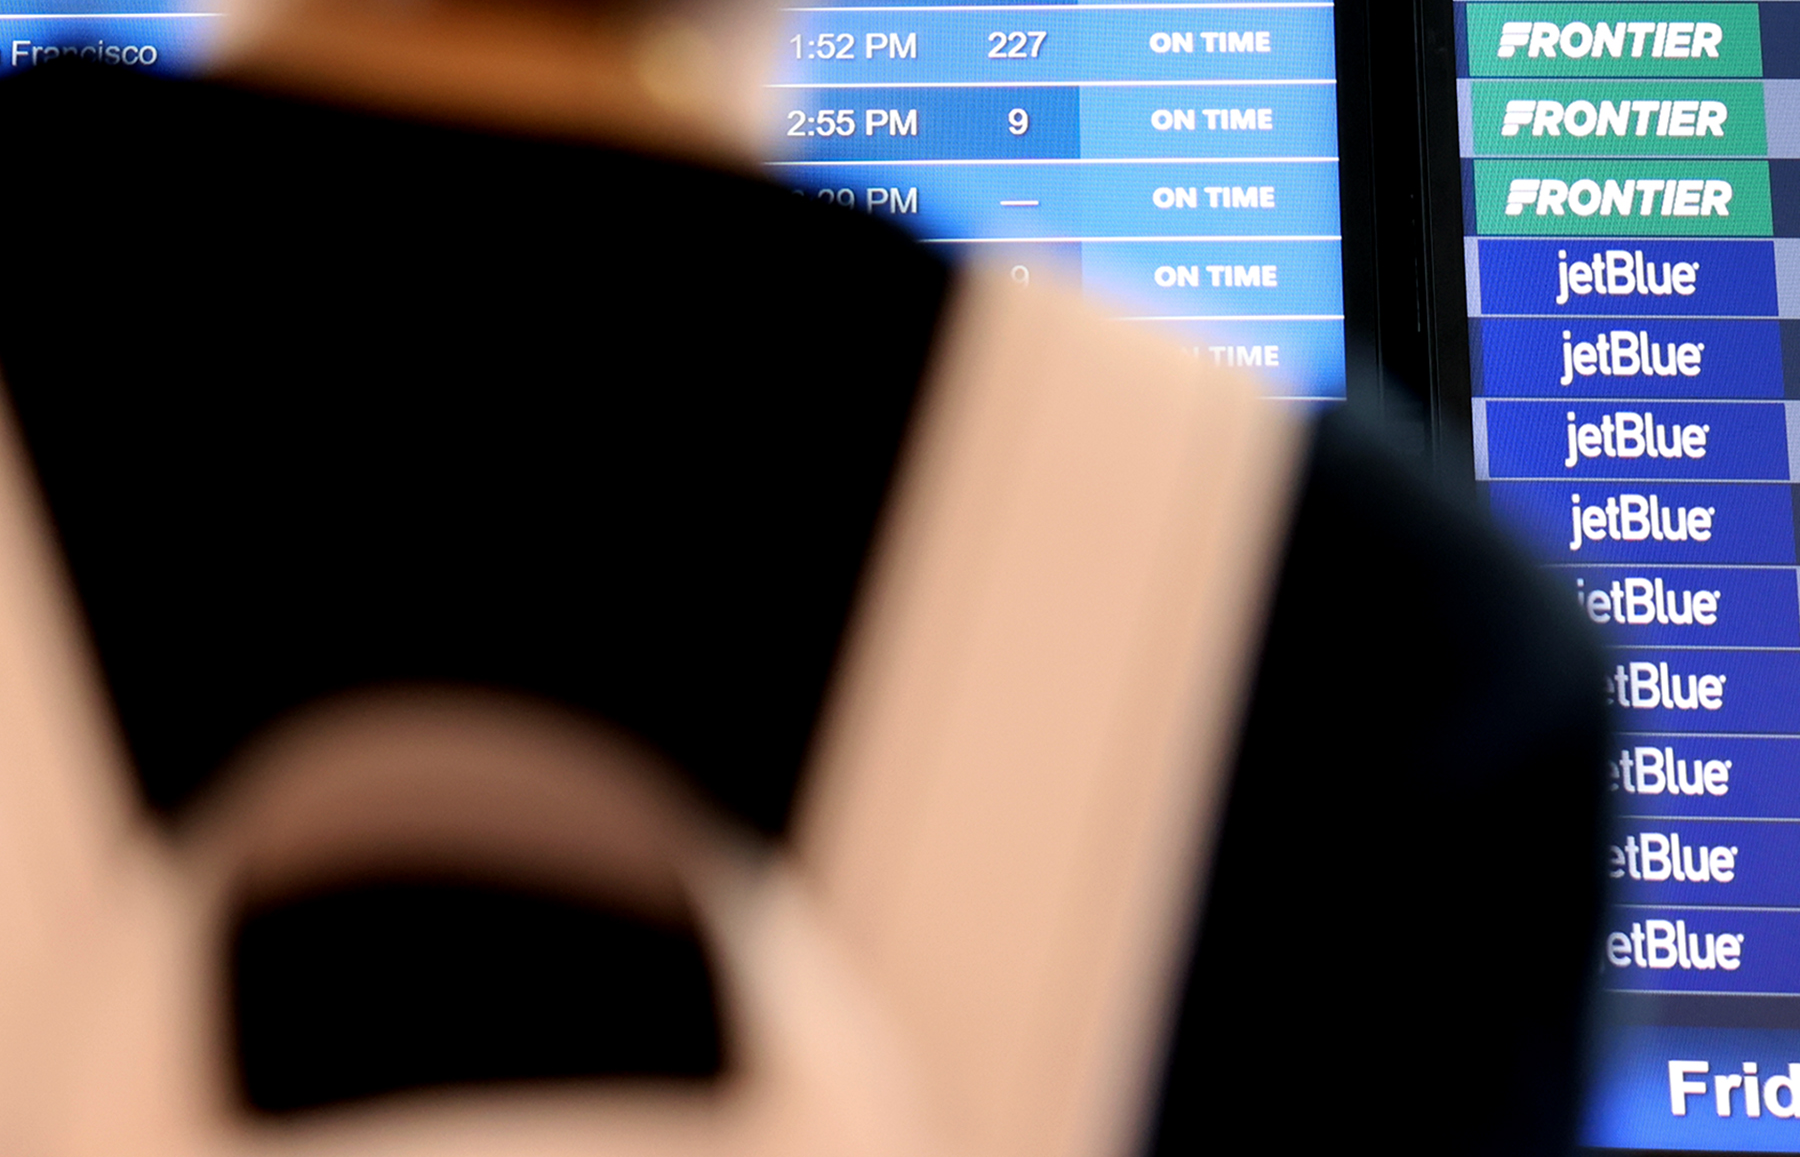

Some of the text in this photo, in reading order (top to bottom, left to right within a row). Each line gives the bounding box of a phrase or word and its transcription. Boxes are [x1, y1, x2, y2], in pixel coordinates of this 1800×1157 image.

[789, 30, 1270, 59] 1:52 PM 227 ON TIME
[787, 108, 1029, 136] 2:55 PM 9
[1501, 100, 1728, 137] FRONTIER
[867, 188, 918, 214] PM
[1152, 187, 1197, 208] ON
[1204, 185, 1274, 207] TIME
[1505, 179, 1732, 216] FRONTIER
[1154, 264, 1277, 287] ON TIME
[1556, 250, 1696, 305] jetBlue
[1208, 345, 1279, 367] TIME
[1560, 330, 1702, 385] jetBlue
[1565, 412, 1706, 467] jetBlue
[1570, 494, 1712, 550] jetBlue
[1606, 919, 1741, 971] etBlue
